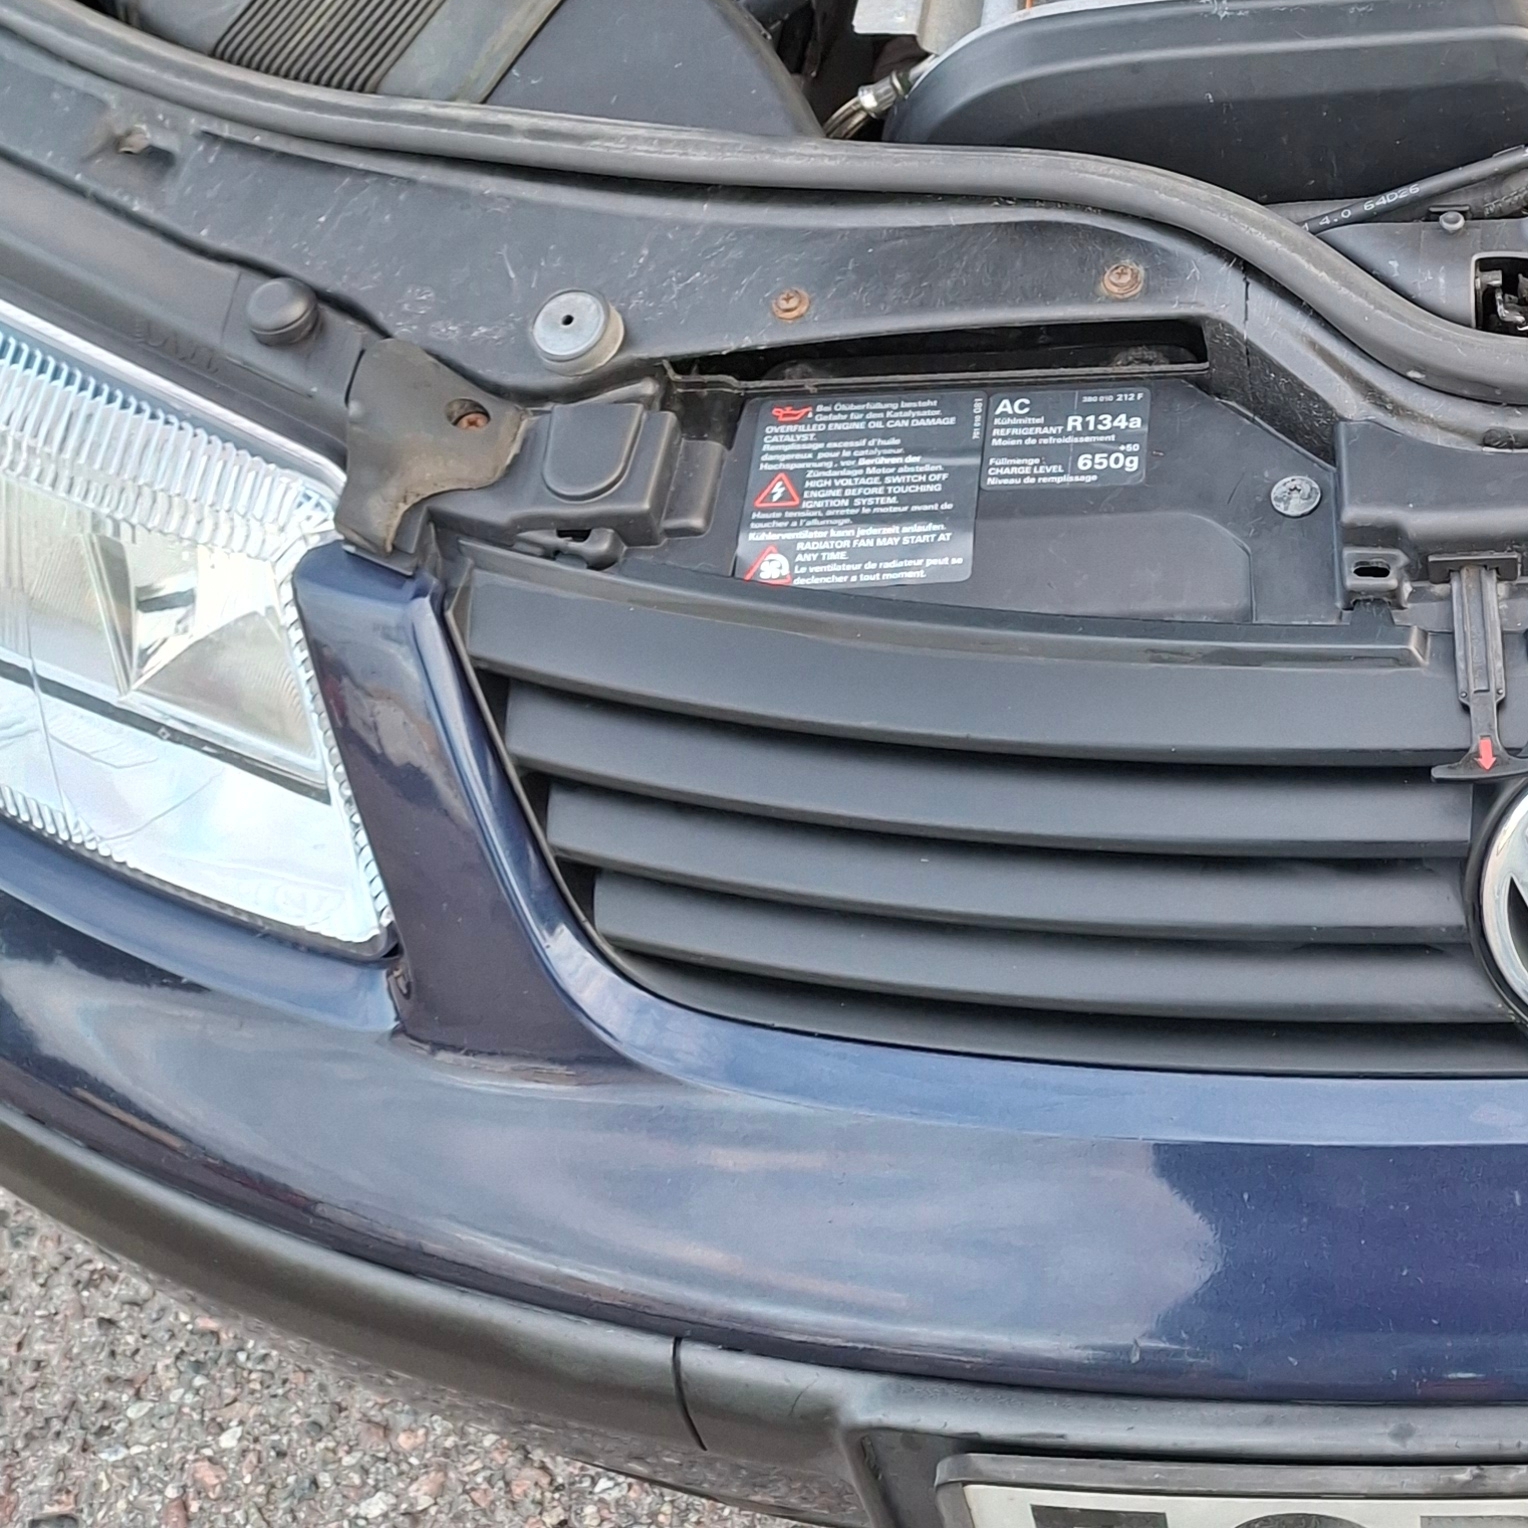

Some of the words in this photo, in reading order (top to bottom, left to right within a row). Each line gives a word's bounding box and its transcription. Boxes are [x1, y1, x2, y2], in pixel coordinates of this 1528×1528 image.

[1318, 208, 1352, 226] 4.0
[1362, 183, 1421, 212] 64D26
[1115, 393, 1135, 402] 212
[1136, 392, 1145, 401] F
[994, 397, 1031, 415] AC
[815, 412, 848, 422] Gefahr
[865, 411, 885, 419] den
[993, 415, 1045, 425] Kühlmittel
[1066, 413, 1142, 432] R134a
[765, 422, 826, 434] OVERFILLED
[827, 421, 866, 431] ENGINE
[867, 419, 885, 429] OIL
[886, 418, 909, 428] CAN
[910, 416, 957, 427] DAMAGE
[992, 425, 1064, 437] REFRIGERANT
[763, 433, 817, 443] CATALYST.
[991, 437, 1023, 446] Moien
[1024, 435, 1037, 445] de
[1038, 434, 1116, 444] refroidissement
[816, 451, 840, 460] pour
[841, 449, 852, 458] le
[904, 454, 922, 463] der
[1077, 451, 1139, 472] 650g
[865, 466, 896, 475] Motor
[987, 466, 1032, 476] CHARGE
[1033, 464, 1064, 473] LEVEL
[804, 478, 832, 488] HIGH
[883, 474, 926, 484] SWITCH
[928, 473, 949, 482] OFF
[986, 476, 1021, 485] Niveau
[1023, 475, 1036, 484] de
[1037, 473, 1098, 484] remplissage
[803, 488, 842, 499] ENGINE
[843, 486, 885, 497] BEFORE
[886, 483, 942, 494] TOUCHING
[801, 498, 849, 509] IGNITION
[853, 496, 899, 506] SYSTEM.
[751, 511, 782, 520] Haute
[872, 505, 909, 514] moteur
[910, 503, 938, 512] avant
[940, 501, 954, 510] de
[750, 520, 789, 529] toucher
[830, 528, 855, 538] kann
[856, 525, 900, 538] jederzeit
[796, 539, 851, 551] RADIATOR
[852, 537, 874, 548] FAN
[876, 536, 901, 546] MAY
[902, 533, 937, 545] START
[937, 532, 952, 542] AT
[794, 552, 820, 562] ANY
[794, 564, 807, 574] Le
[808, 562, 862, 572] ventilateur
[863, 561, 877, 570] de
[879, 558, 924, 569] radiateur
[925, 556, 949, 567] peut
[793, 574, 848, 585] declencher
[859, 572, 880, 581] tout
